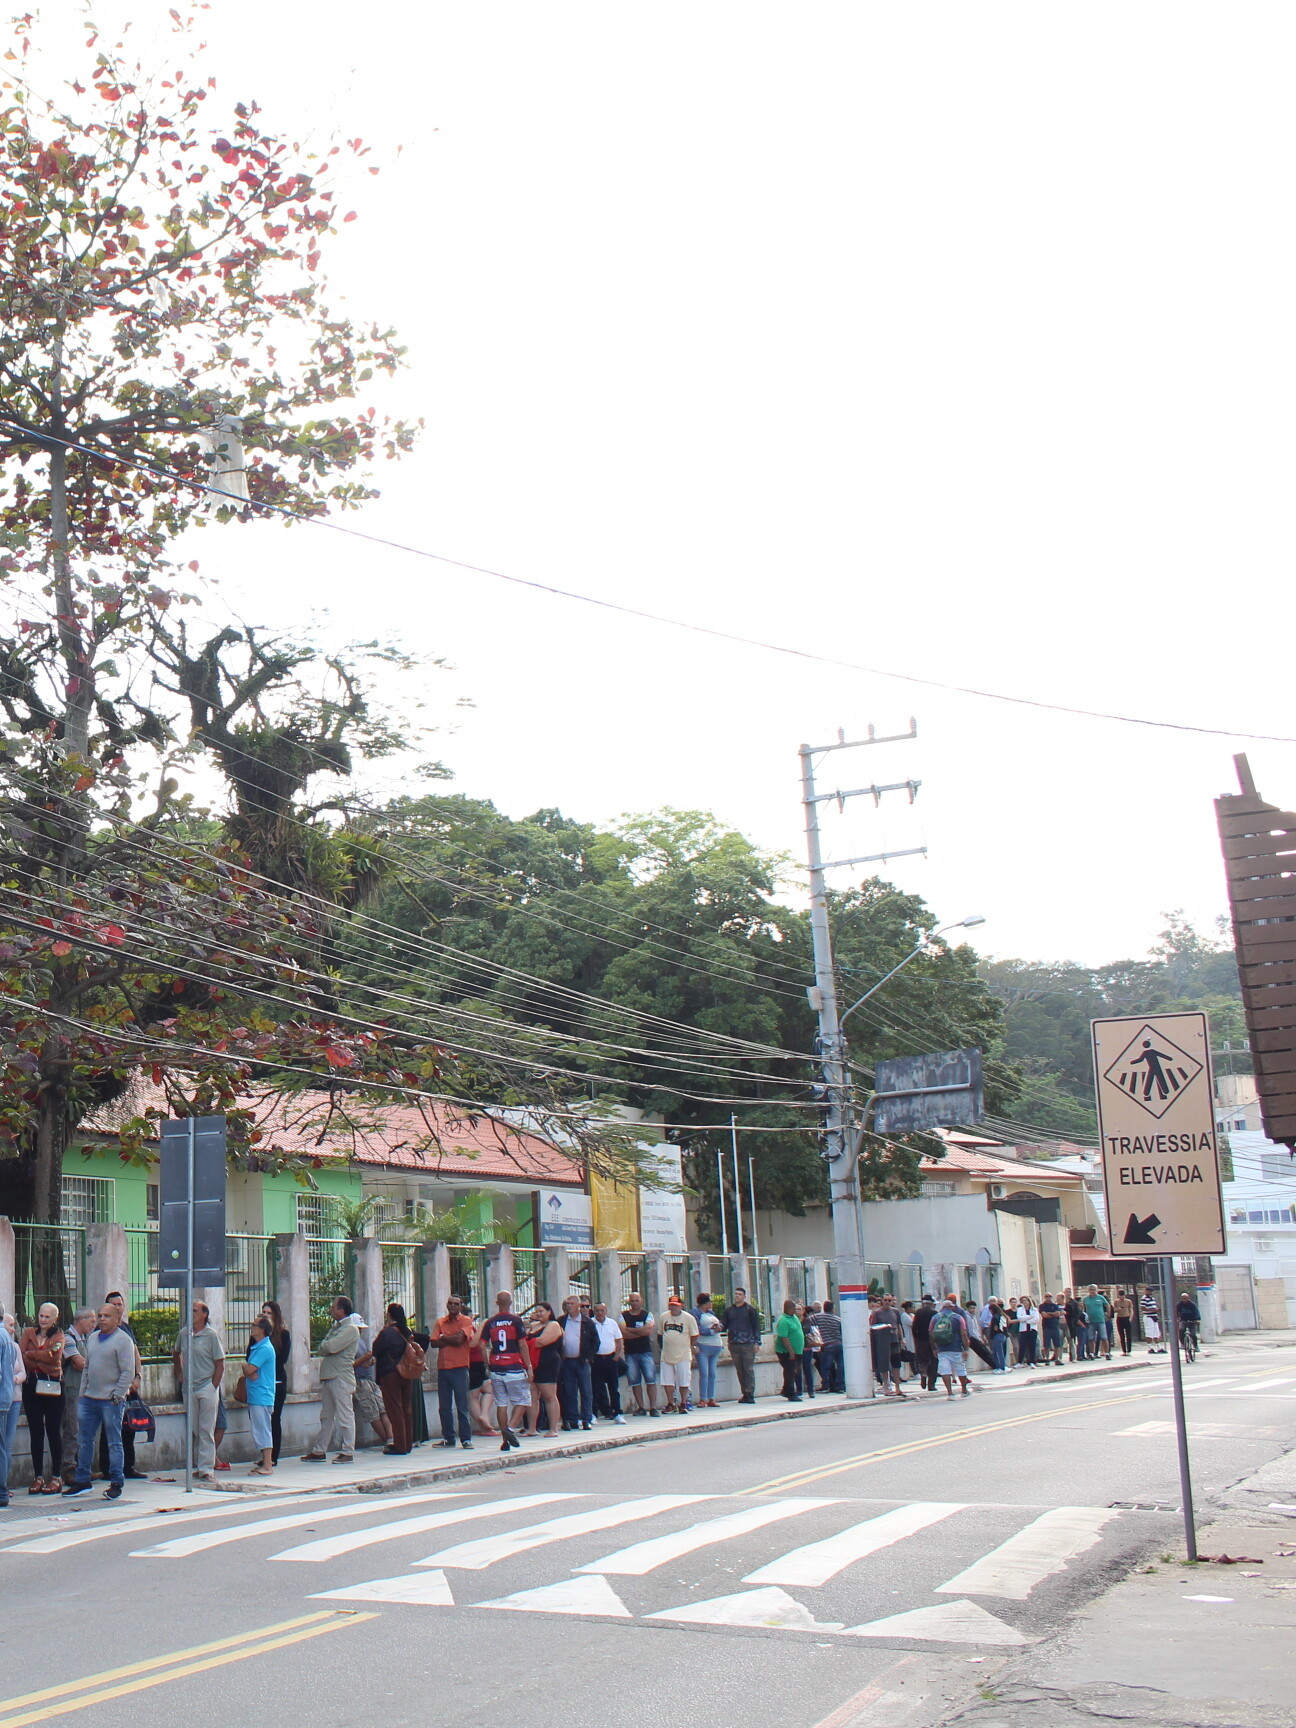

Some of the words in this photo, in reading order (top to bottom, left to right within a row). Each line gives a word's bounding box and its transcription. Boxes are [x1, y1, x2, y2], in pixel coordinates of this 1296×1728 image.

[1108, 1132, 1212, 1155] TRAVESSIA
[1119, 1164, 1204, 1186] ELEVADA
[498, 1329, 507, 1352] 9
